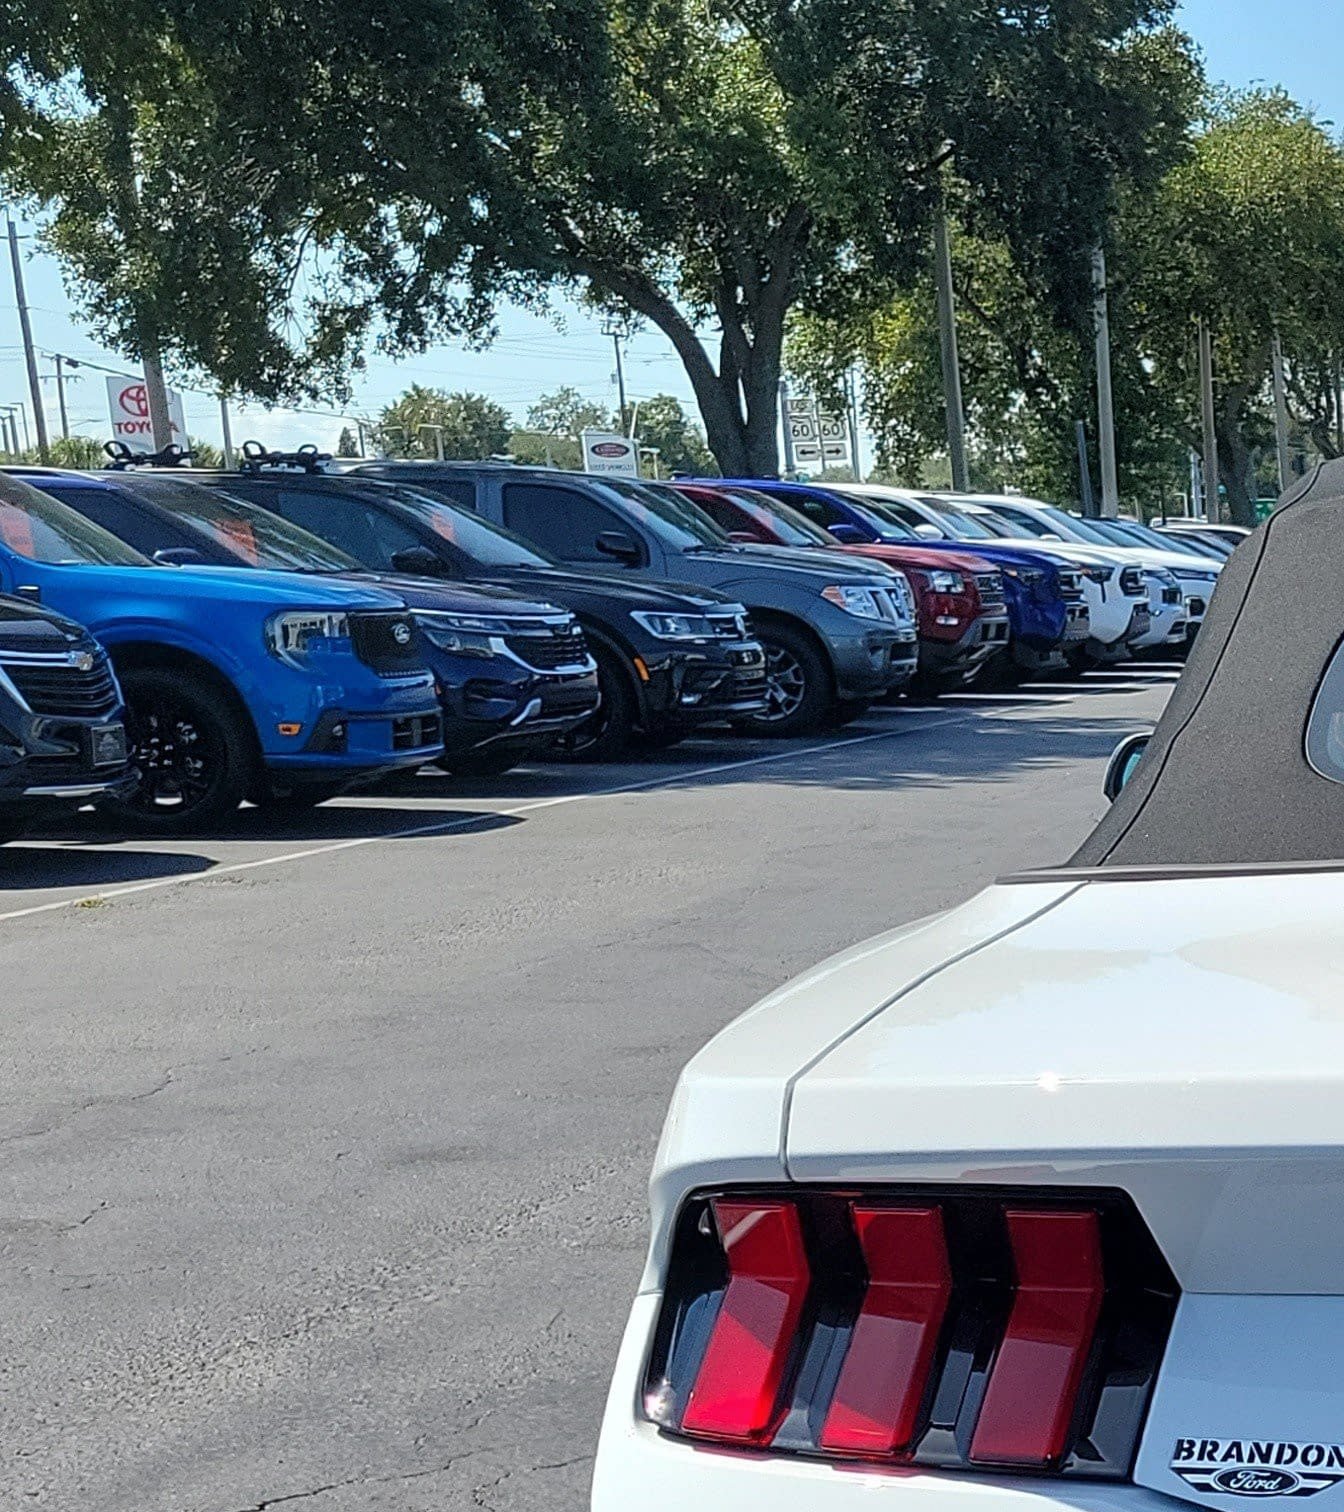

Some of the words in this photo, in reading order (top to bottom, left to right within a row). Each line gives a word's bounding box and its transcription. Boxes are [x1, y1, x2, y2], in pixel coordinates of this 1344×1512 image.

[114, 421, 180, 434] TOYA
[792, 424, 810, 437] 60
[822, 423, 840, 436] 60
[1229, 1470, 1283, 1490] Ford
